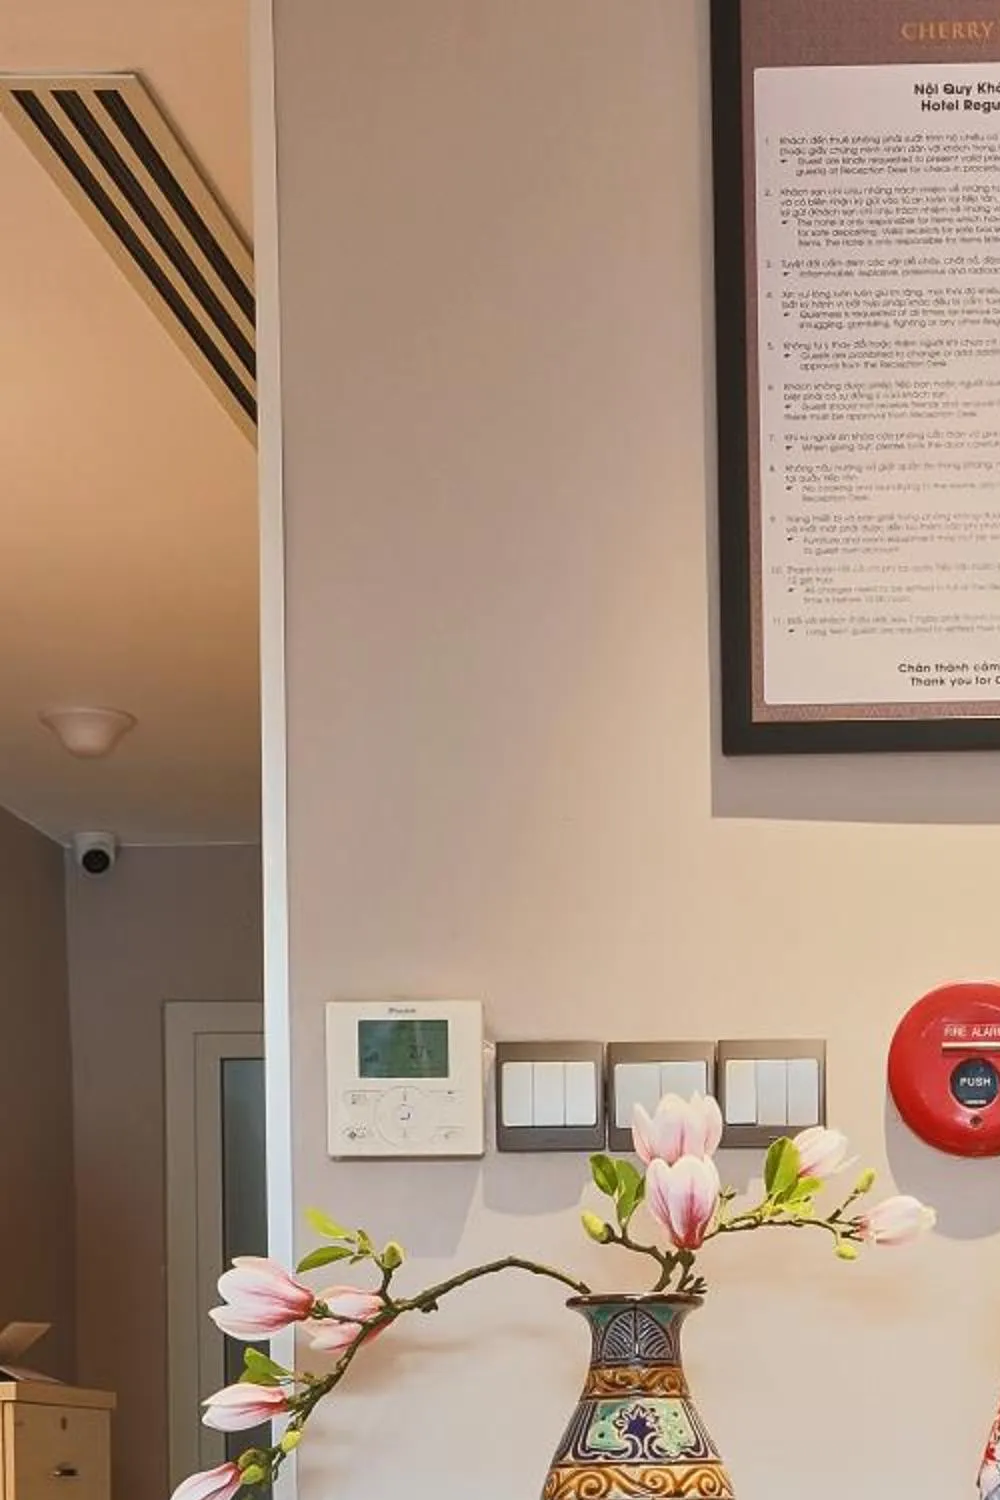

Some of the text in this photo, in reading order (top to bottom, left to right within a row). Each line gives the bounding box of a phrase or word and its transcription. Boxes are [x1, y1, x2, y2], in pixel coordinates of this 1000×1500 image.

[901, 20, 994, 41] CHERRY
[914, 82, 939, 98] Nội
[943, 83, 972, 97] Quy
[921, 98, 959, 112] Hotel
[935, 662, 969, 673] thành
[911, 676, 946, 687] Thank
[949, 677, 972, 688] you
[975, 674, 992, 685] for
[944, 1027, 968, 1036] FIRE
[959, 1077, 991, 1087] PUSH
